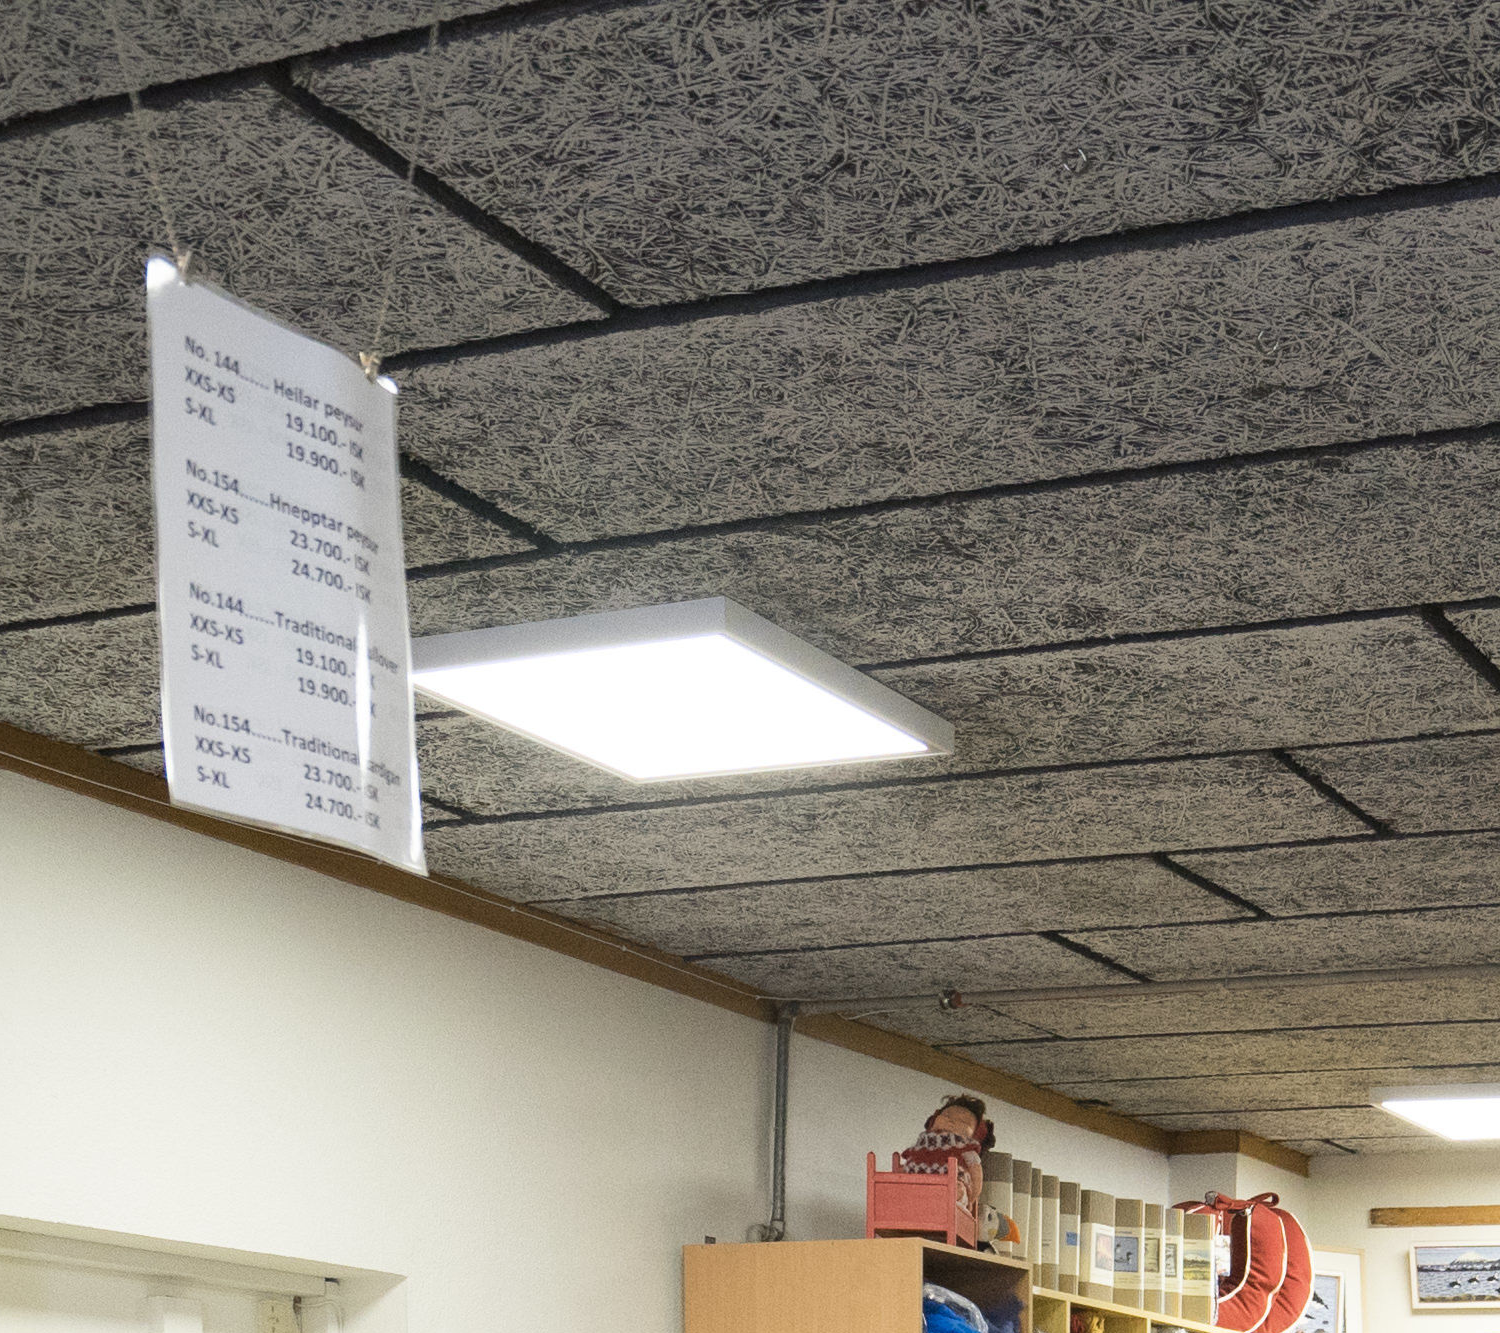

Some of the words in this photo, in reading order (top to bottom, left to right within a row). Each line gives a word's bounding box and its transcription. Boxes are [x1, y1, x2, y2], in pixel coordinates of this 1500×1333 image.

[185, 366, 236, 404] XXS-XS
[185, 397, 217, 426] S-XL
[186, 489, 239, 525] XXS-XS
[187, 521, 219, 548] S-XL
[190, 613, 244, 645] XXS-XS
[191, 644, 224, 669] S-XL
[195, 736, 251, 764] XXS-XS
[197, 765, 230, 789] S-XL
